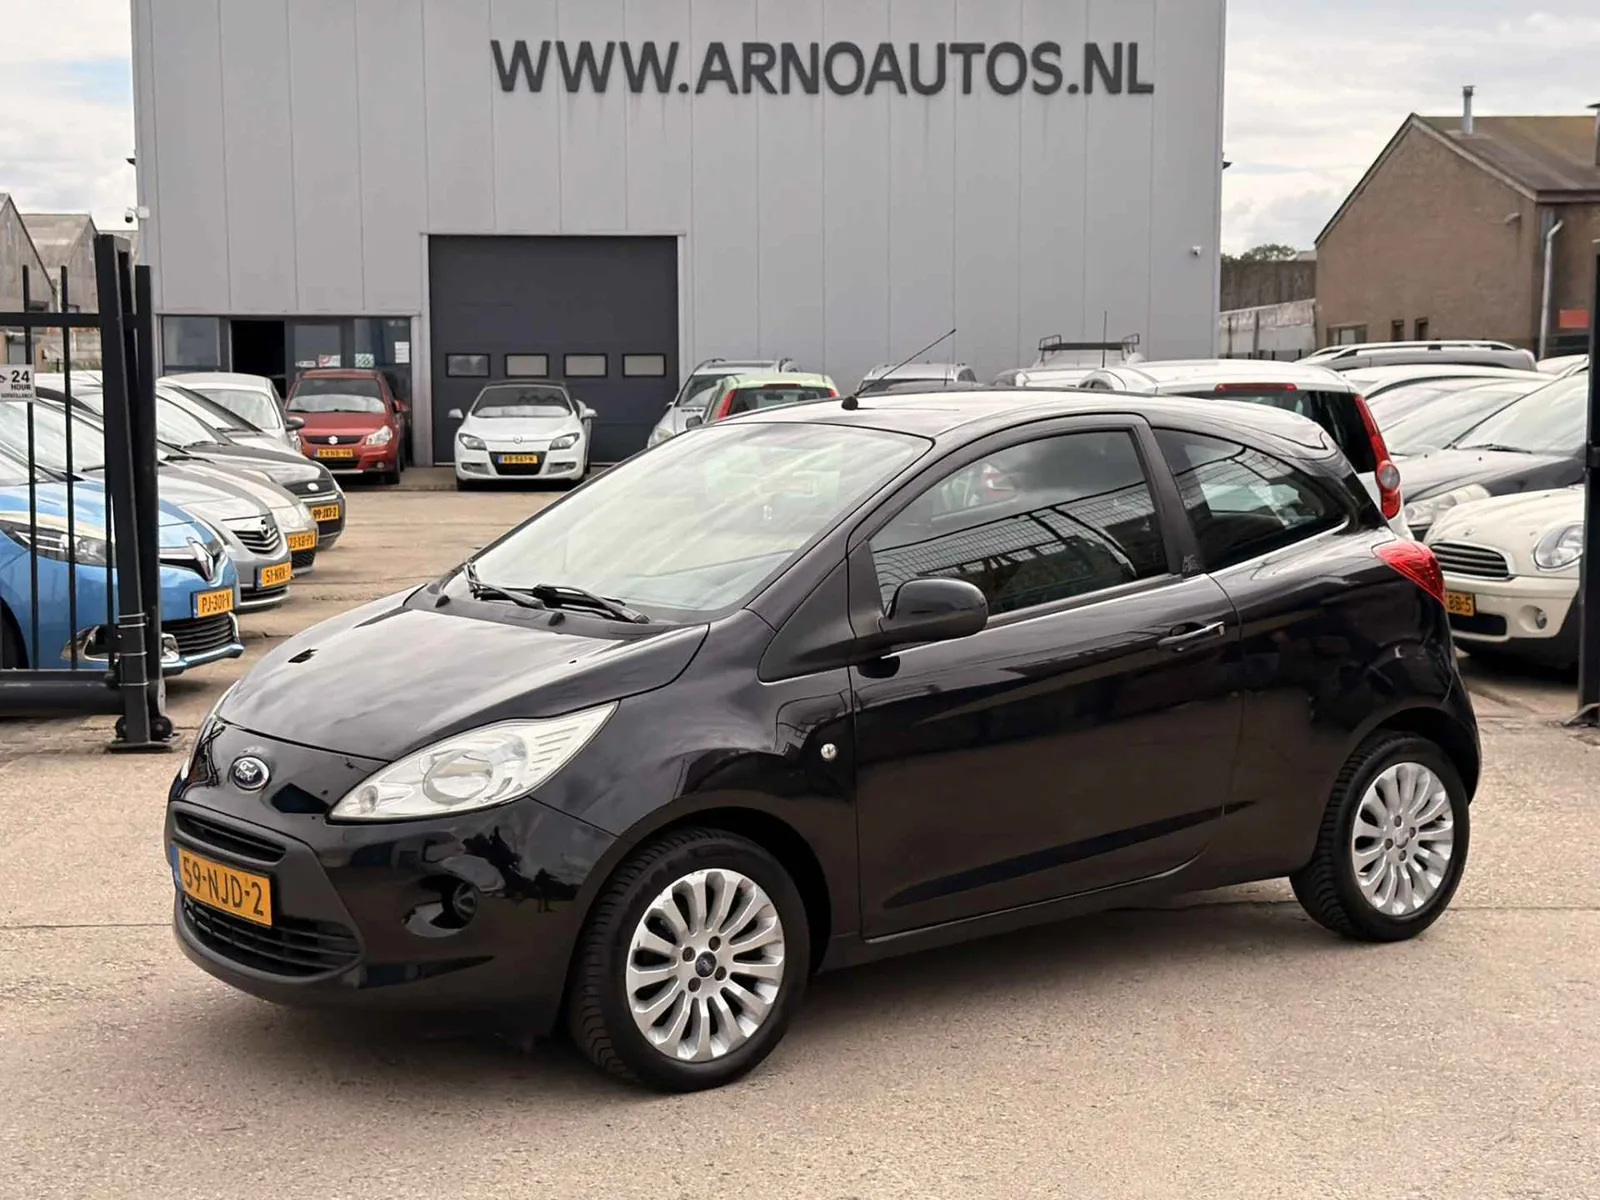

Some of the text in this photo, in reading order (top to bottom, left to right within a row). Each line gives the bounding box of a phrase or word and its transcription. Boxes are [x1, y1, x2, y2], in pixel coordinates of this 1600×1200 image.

[490, 40, 1155, 96] WWW.ARNOAUTOS.NL
[11, 370, 30, 383] 24
[182, 856, 265, 917] 59-NJD-2
